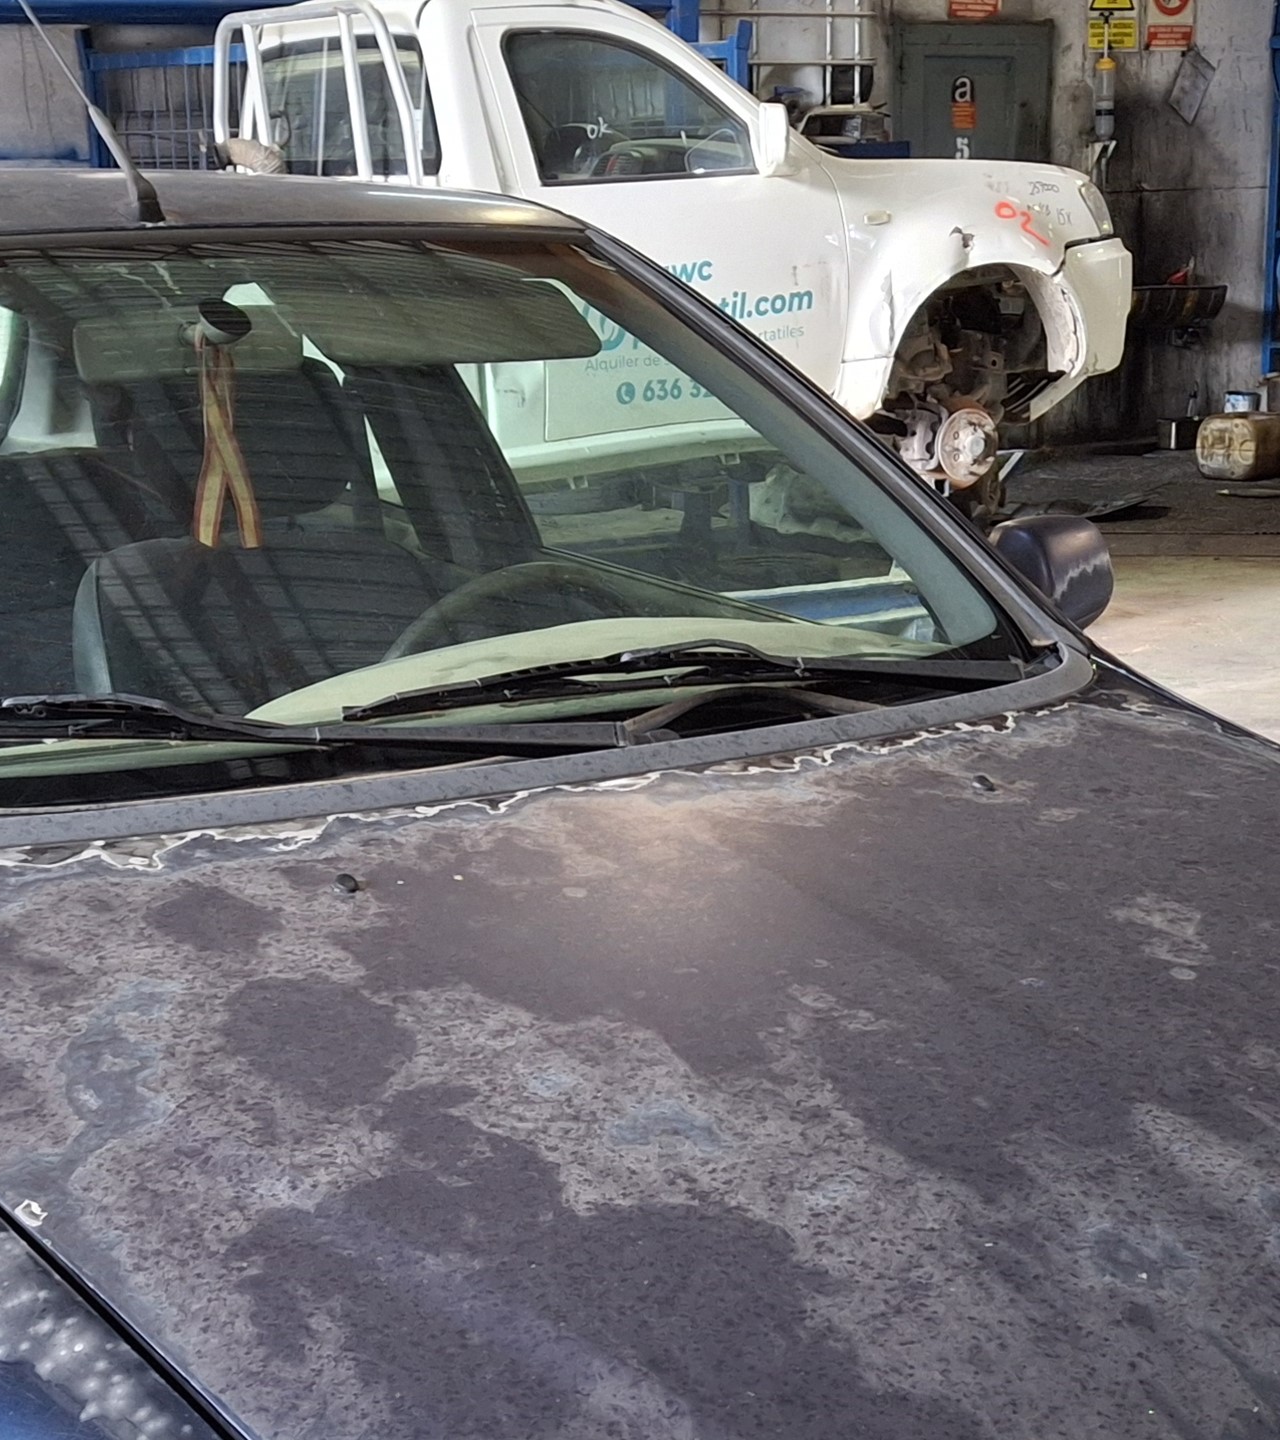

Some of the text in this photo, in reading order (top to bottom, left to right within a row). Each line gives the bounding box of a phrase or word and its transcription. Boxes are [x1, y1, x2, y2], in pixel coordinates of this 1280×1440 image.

[955, 136, 970, 159] 5
[665, 259, 713, 283] wc
[584, 355, 660, 373] Alquiler de
[642, 378, 682, 402] 636
